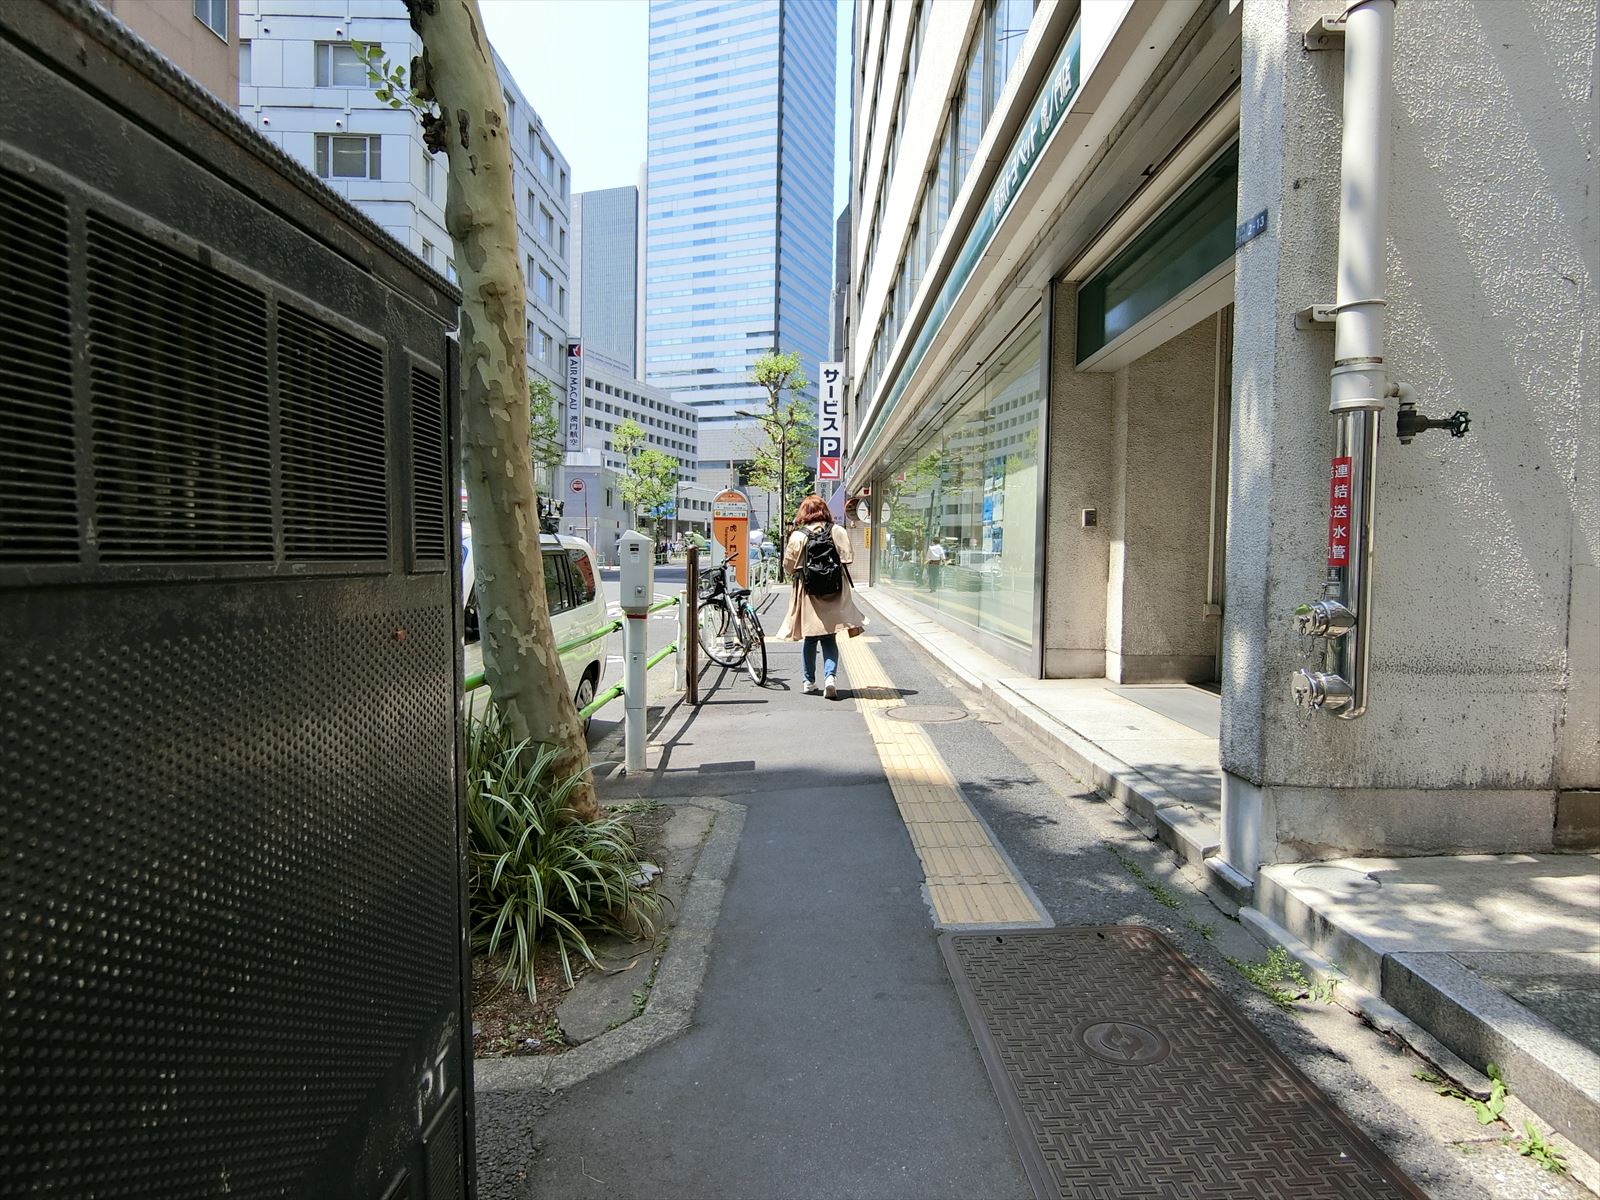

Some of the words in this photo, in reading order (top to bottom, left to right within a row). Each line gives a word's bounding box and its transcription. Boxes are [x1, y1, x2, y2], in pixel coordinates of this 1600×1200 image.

[992, 121, 1037, 226] 東京トヨペット
[1040, 56, 1072, 135] 虎ノ門店
[570, 359, 578, 376] AIR
[570, 377, 578, 410] MACAU
[823, 369, 839, 431] サービス
[823, 439, 838, 455] P
[1332, 464, 1349, 559] 連結送水管
